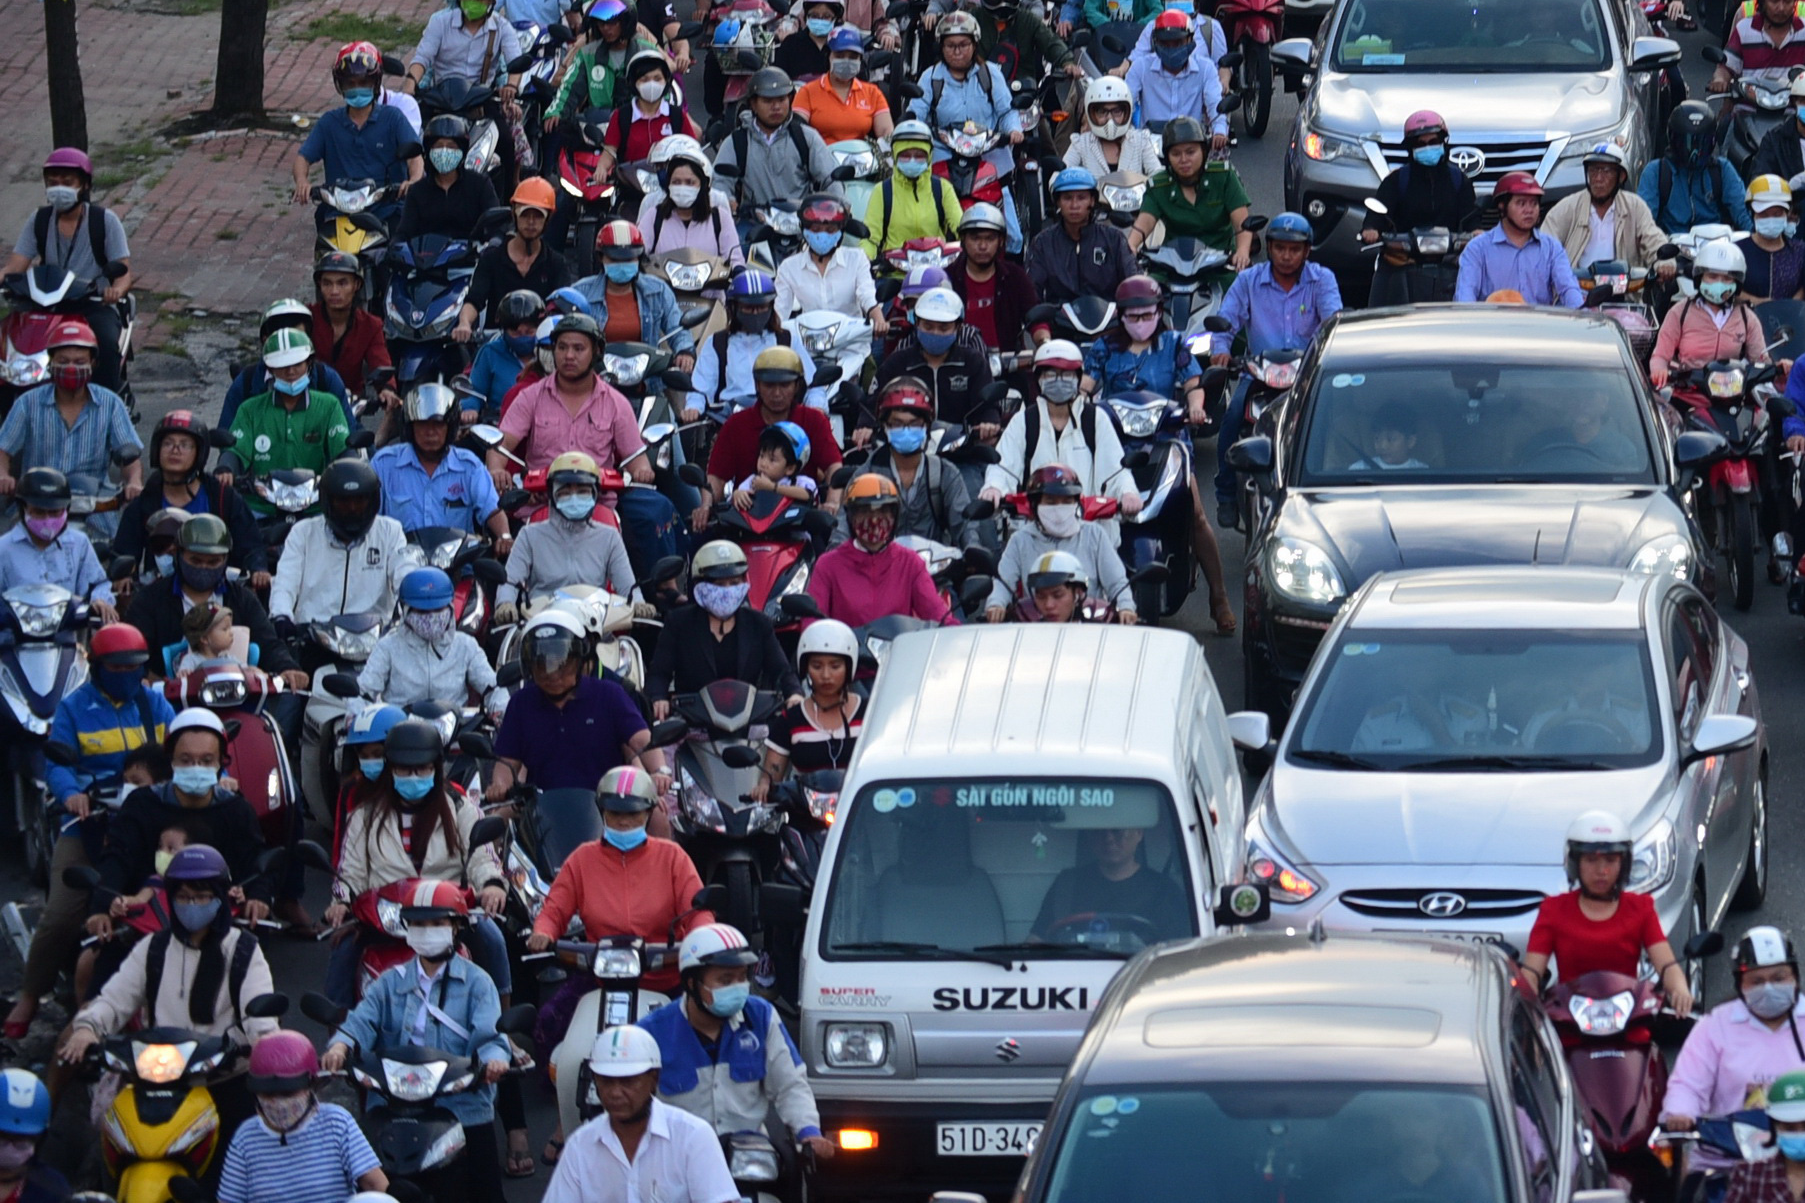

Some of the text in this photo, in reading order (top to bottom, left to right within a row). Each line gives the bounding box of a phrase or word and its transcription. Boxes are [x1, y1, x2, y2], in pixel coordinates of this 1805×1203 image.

[956, 785, 988, 807] SÀI
[1032, 785, 1075, 808] NGÔI
[1080, 788, 1115, 808] SAO
[819, 987, 876, 996] SUPER
[932, 986, 1088, 1012] SUZUKI
[817, 995, 892, 1008] CARRY
